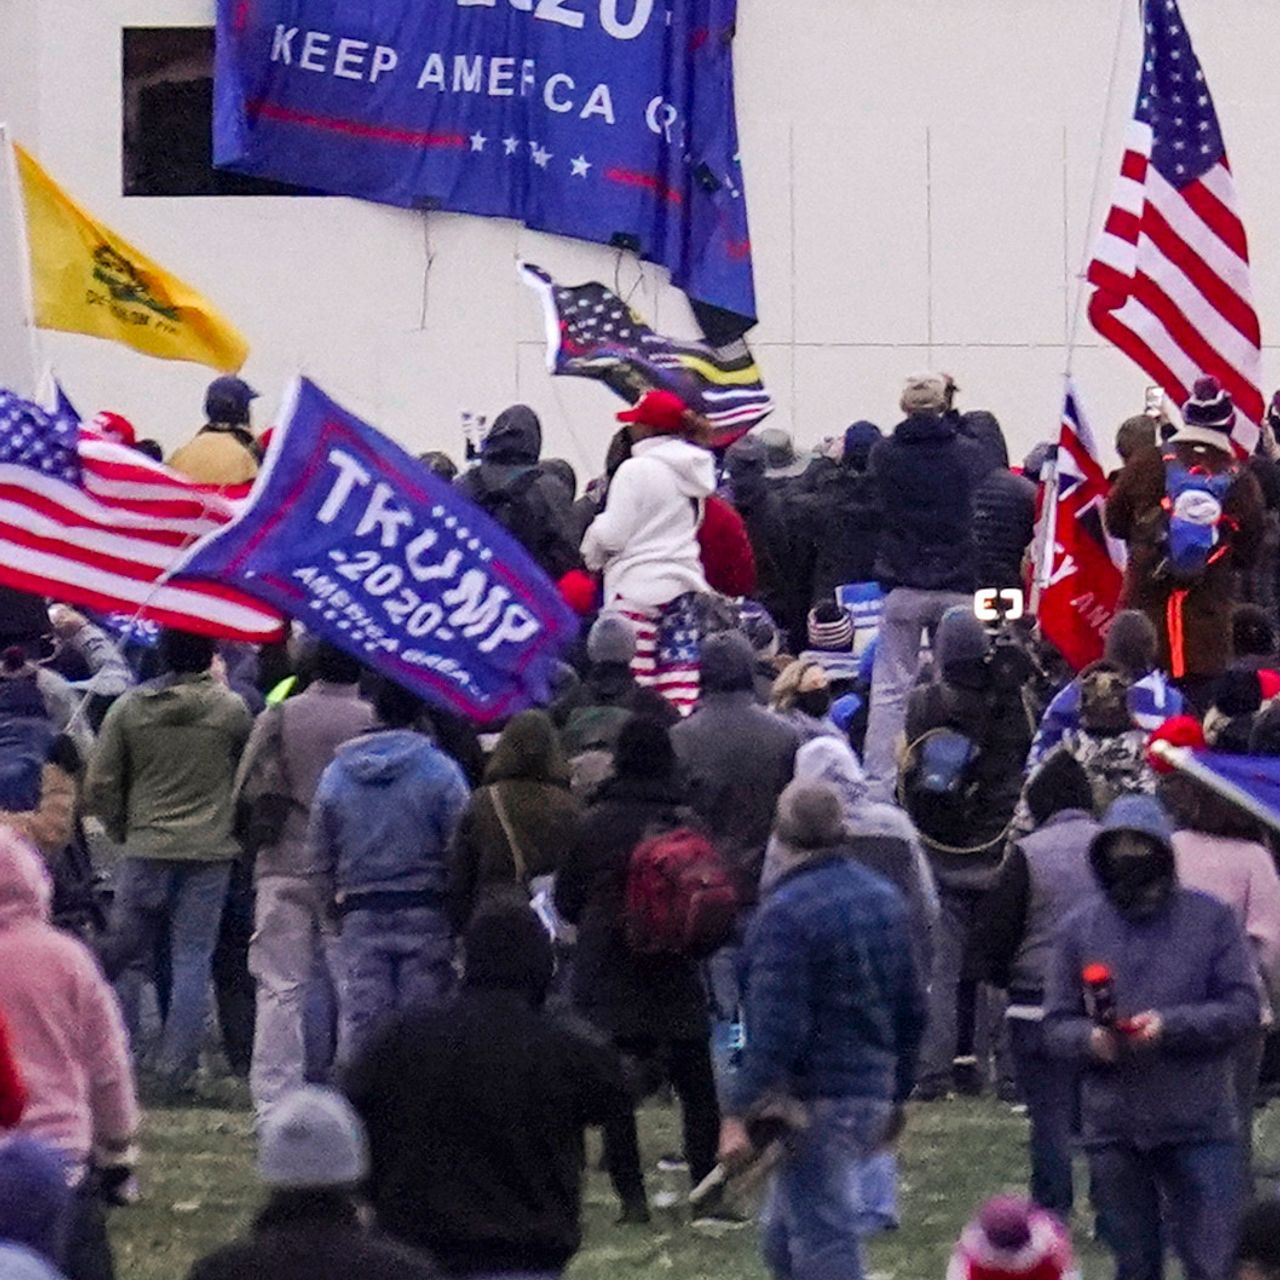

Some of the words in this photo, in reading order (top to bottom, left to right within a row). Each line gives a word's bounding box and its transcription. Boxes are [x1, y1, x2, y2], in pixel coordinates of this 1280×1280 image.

[270, 22, 399, 84] KEEP
[416, 52, 616, 125] AMECA
[315, 448, 541, 653] TRUMP
